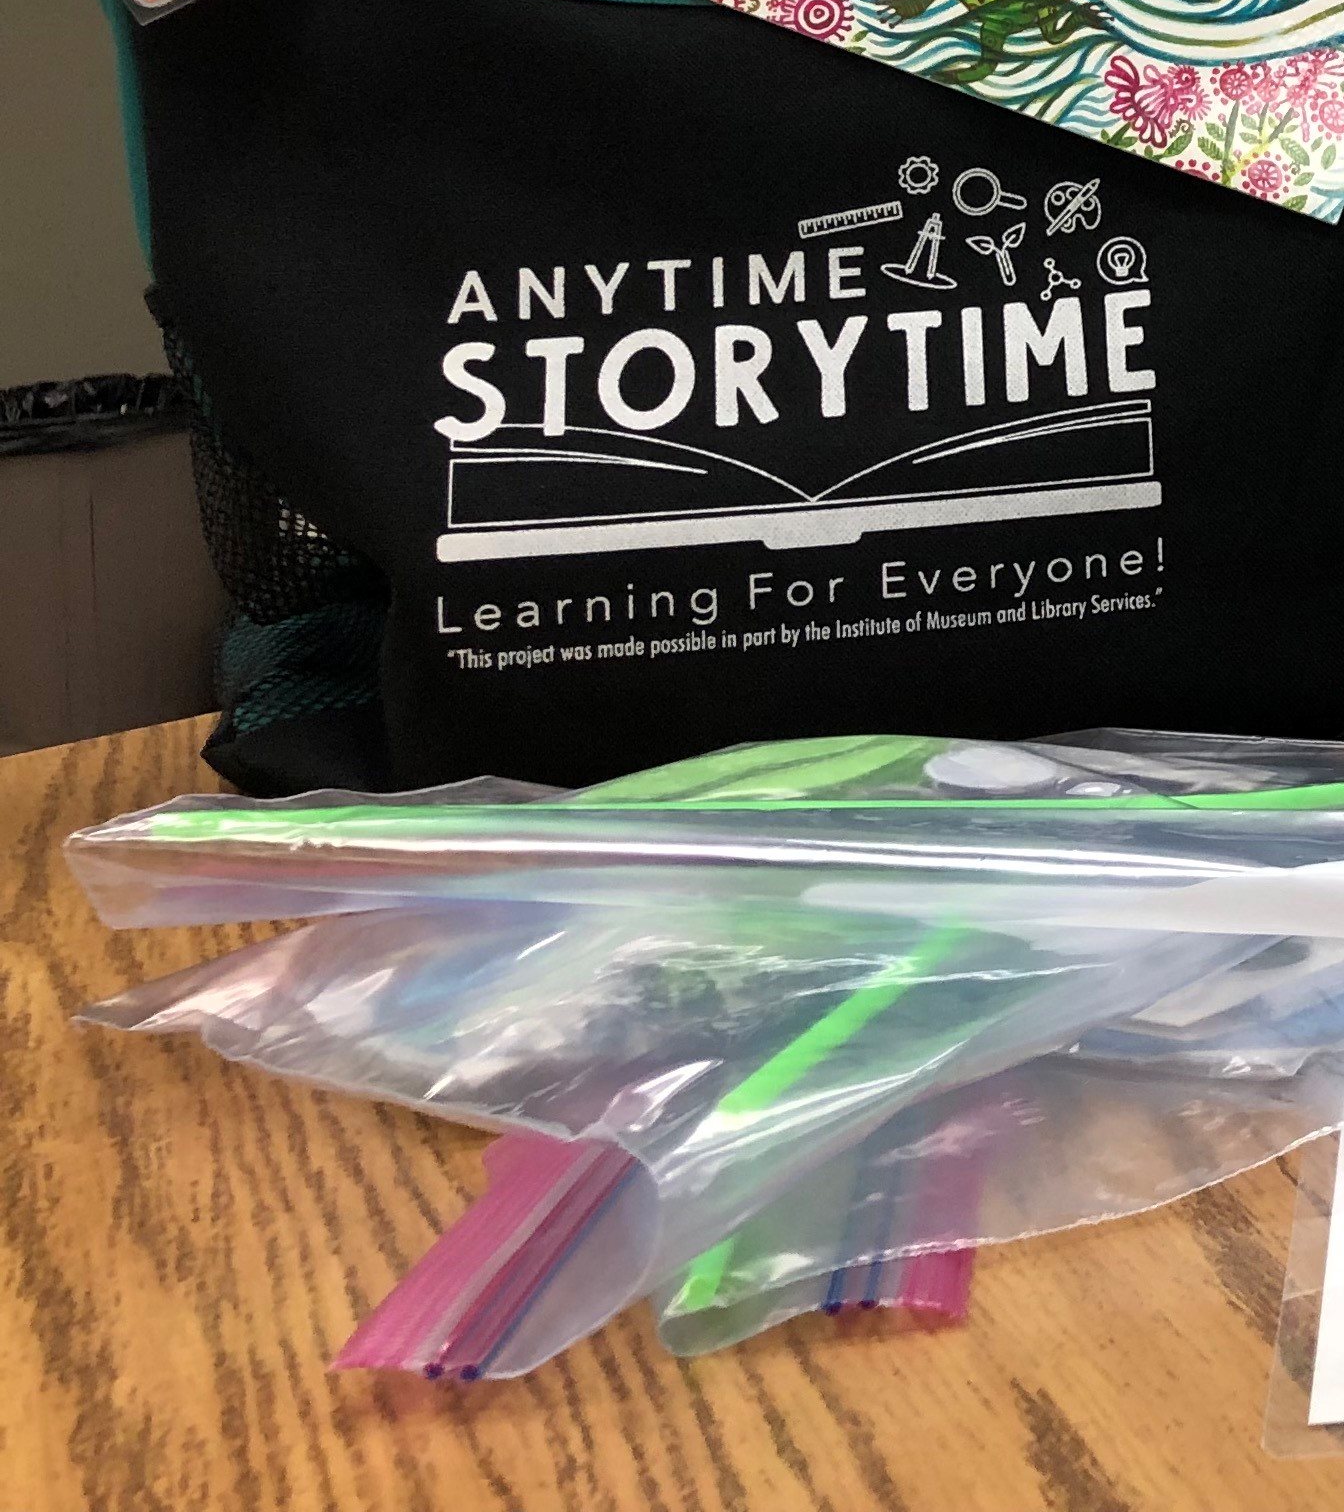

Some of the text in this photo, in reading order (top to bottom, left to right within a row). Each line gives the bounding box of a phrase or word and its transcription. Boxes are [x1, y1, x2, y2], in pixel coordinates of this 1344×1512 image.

[448, 245, 869, 325] ANYTIME
[433, 288, 1159, 443] STORYTIME
[436, 536, 1165, 635] Learning For Everyone!
[497, 644, 555, 671] project
[560, 647, 594, 662] was
[597, 635, 646, 659] made
[649, 631, 717, 660] possible
[721, 628, 738, 649] in
[743, 628, 777, 656] part
[780, 622, 802, 648] by
[805, 621, 832, 642] the
[836, 616, 901, 640] Institute
[905, 610, 923, 633] of
[926, 607, 993, 630] Museum
[996, 602, 1028, 623] and
[1031, 597, 1087, 621] Library
